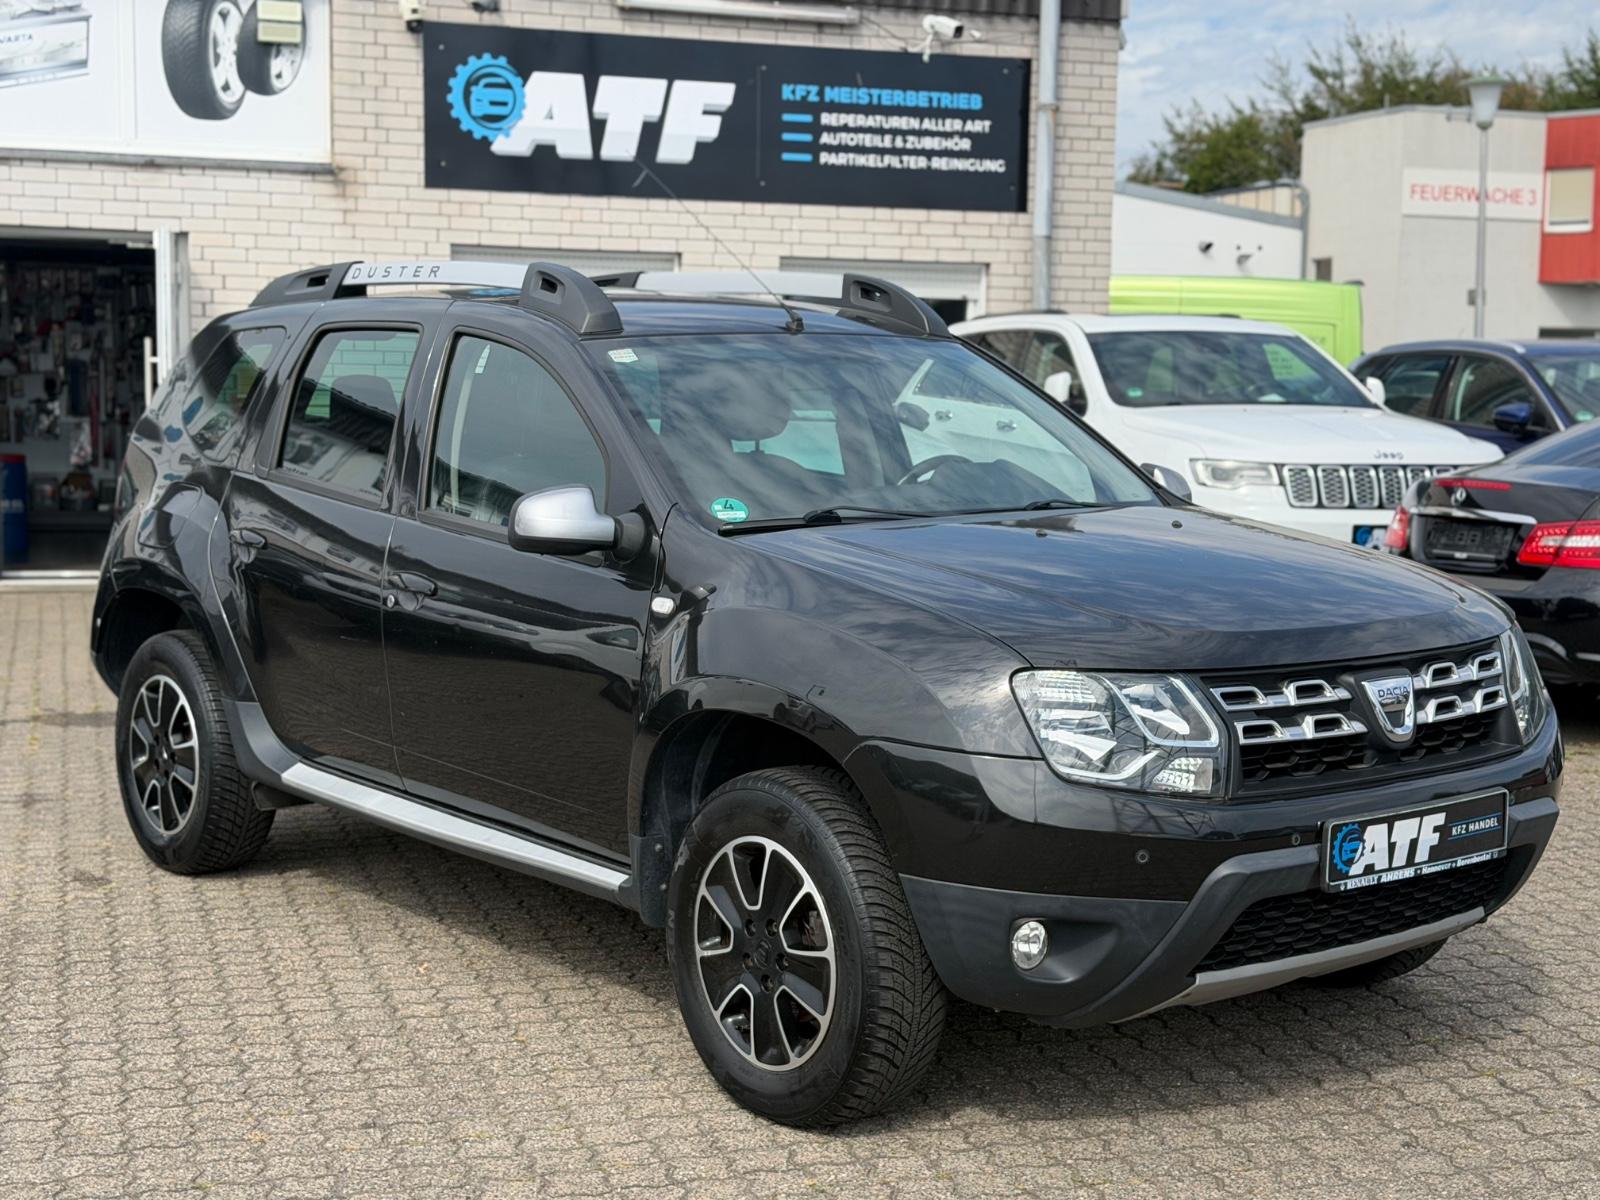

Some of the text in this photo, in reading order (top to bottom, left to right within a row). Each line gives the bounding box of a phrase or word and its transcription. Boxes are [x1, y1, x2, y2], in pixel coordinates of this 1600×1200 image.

[782, 83, 983, 111] KFZ MEISTERBETRIEB
[490, 71, 736, 164] ATF
[820, 112, 992, 134] REPERATUREN ALLER ART
[820, 131, 972, 152] AUTOTEILE & ZUBEHÖR
[819, 152, 1006, 173] PARTIKELFILTER-REINIGUNG
[1528, 188, 1538, 206] 3
[351, 265, 440, 280] DUSTER
[1374, 449, 1404, 460] Jeep
[723, 499, 735, 510] 4
[1377, 686, 1409, 698] DACIA
[1452, 817, 1499, 836] KFZ HANDEL
[1348, 811, 1447, 876] ATF
[1380, 868, 1415, 883] AHRENS
